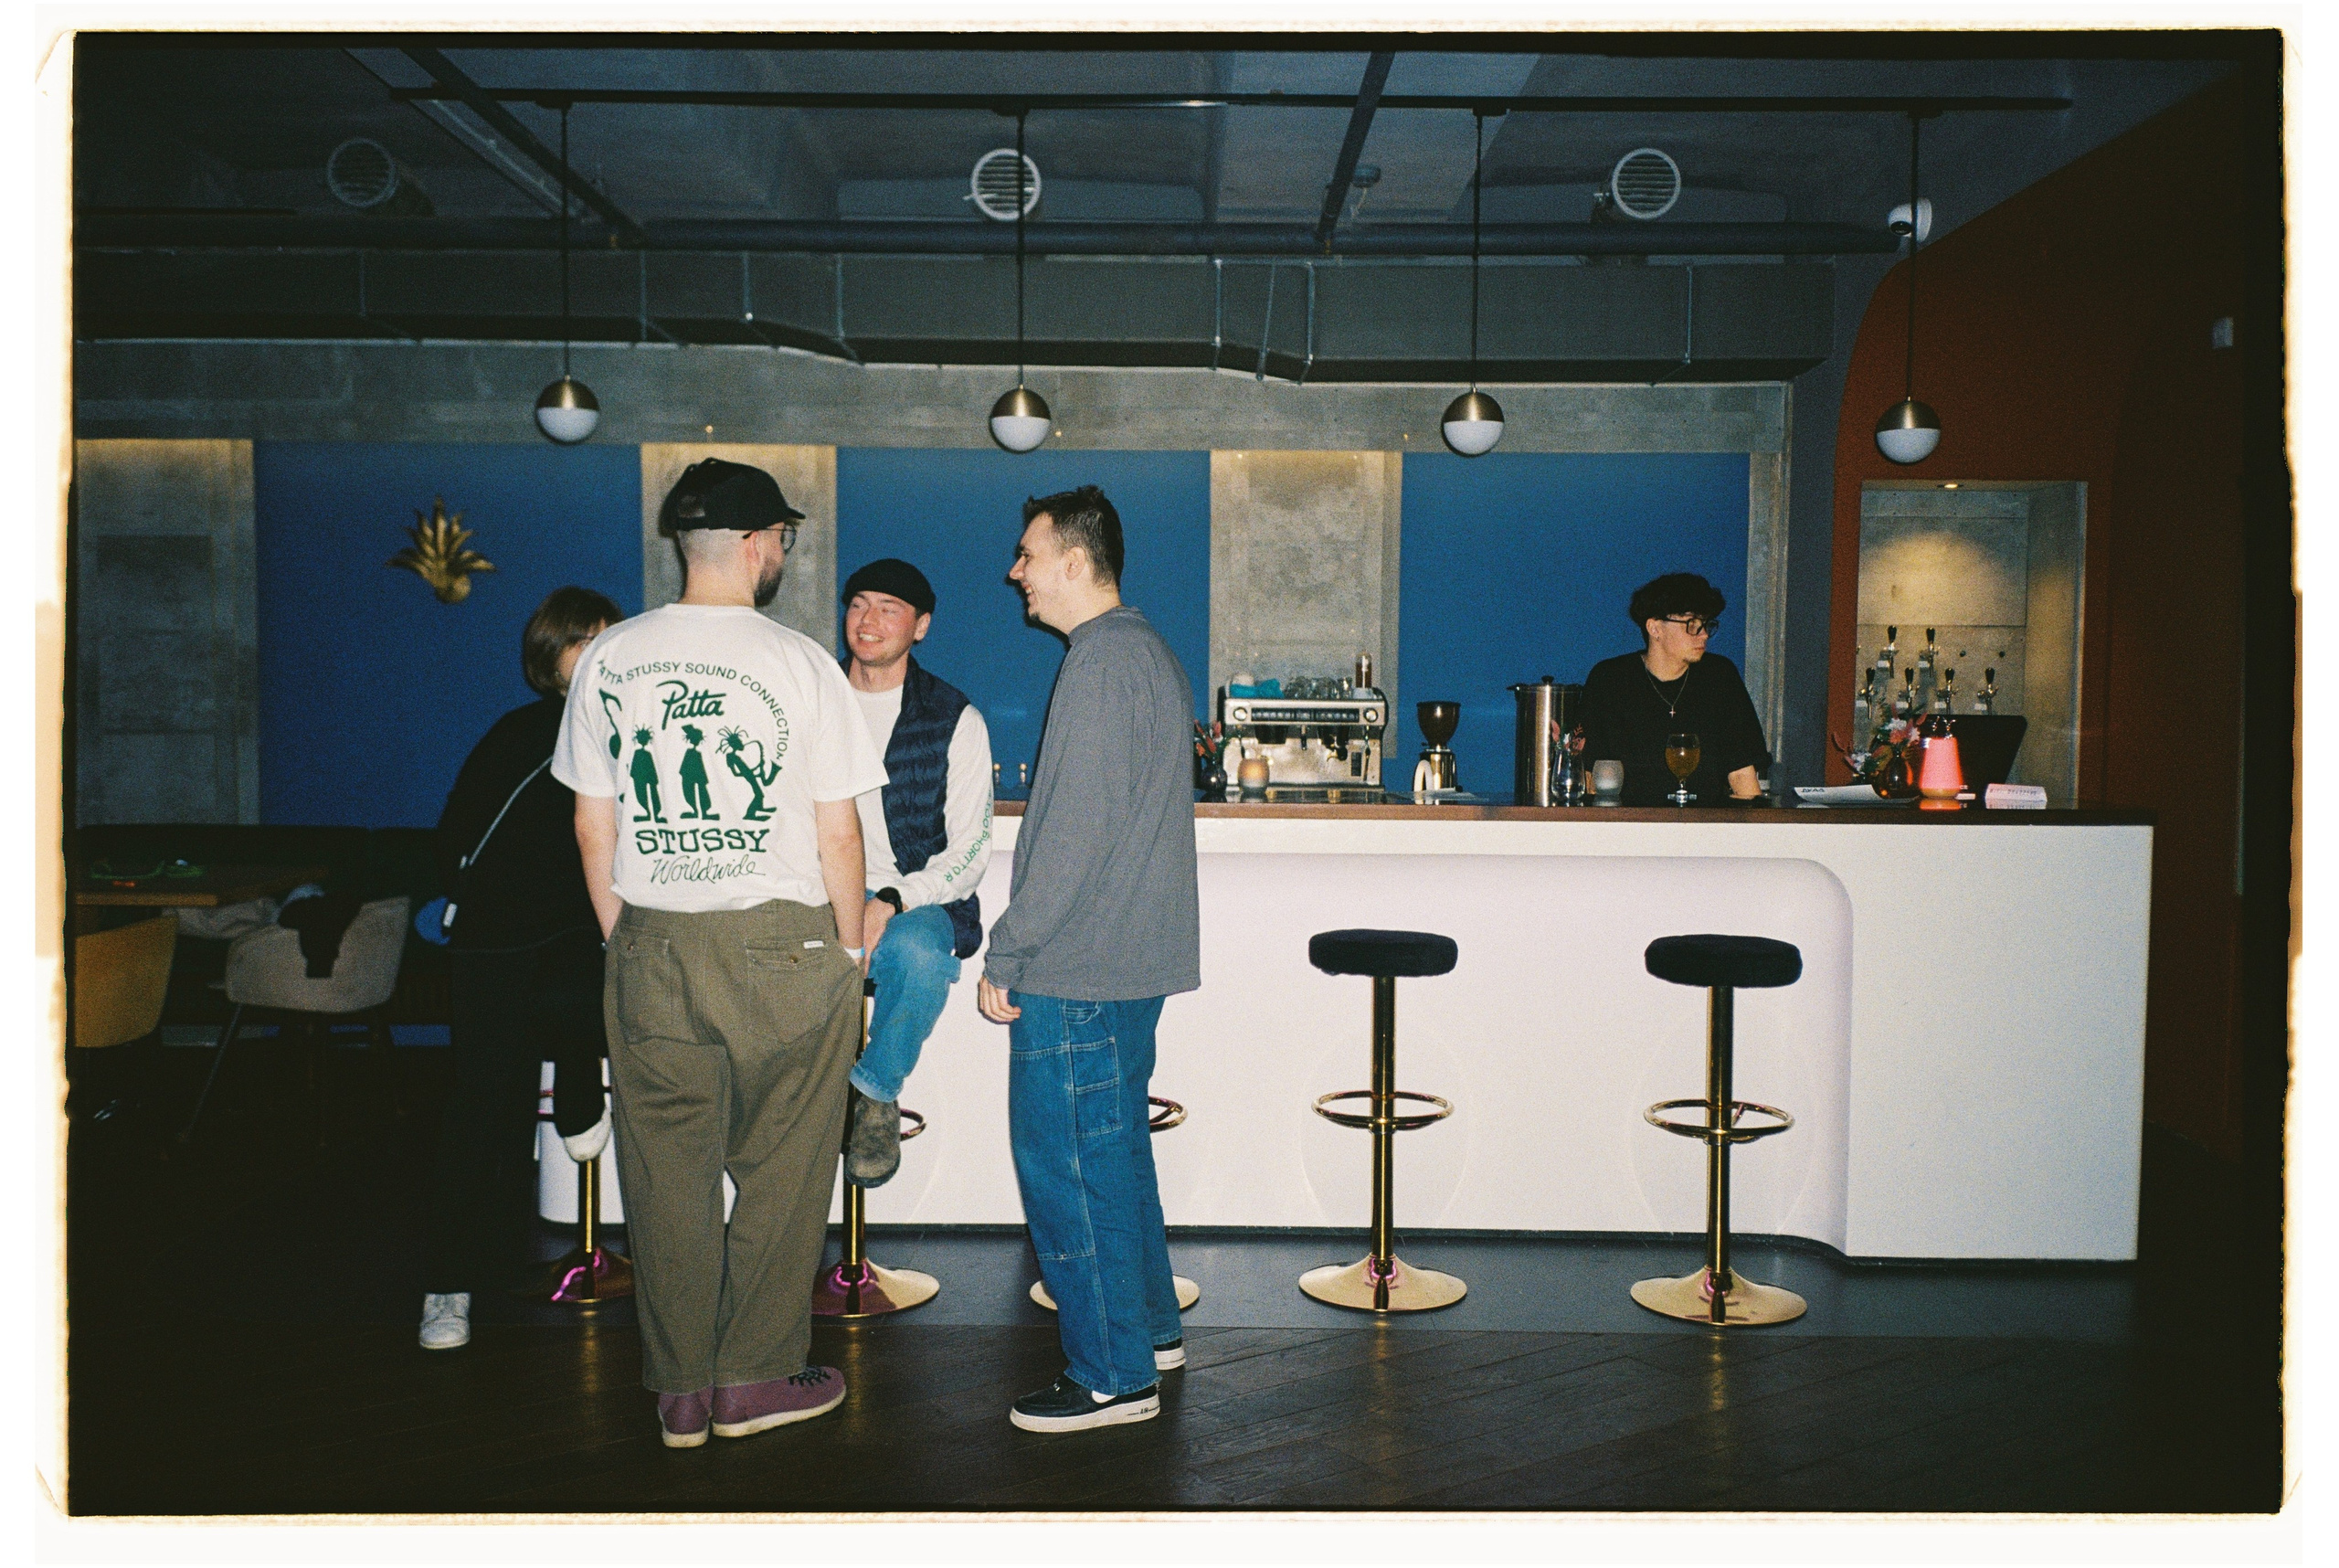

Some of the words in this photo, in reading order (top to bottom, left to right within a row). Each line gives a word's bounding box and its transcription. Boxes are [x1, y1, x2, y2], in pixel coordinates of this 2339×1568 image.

[626, 662, 681, 681] STUSSY
[684, 662, 737, 680] SOUND
[655, 679, 726, 730] Patta
[635, 828, 769, 854] STUSSY
[651, 853, 766, 885] Worldwide
